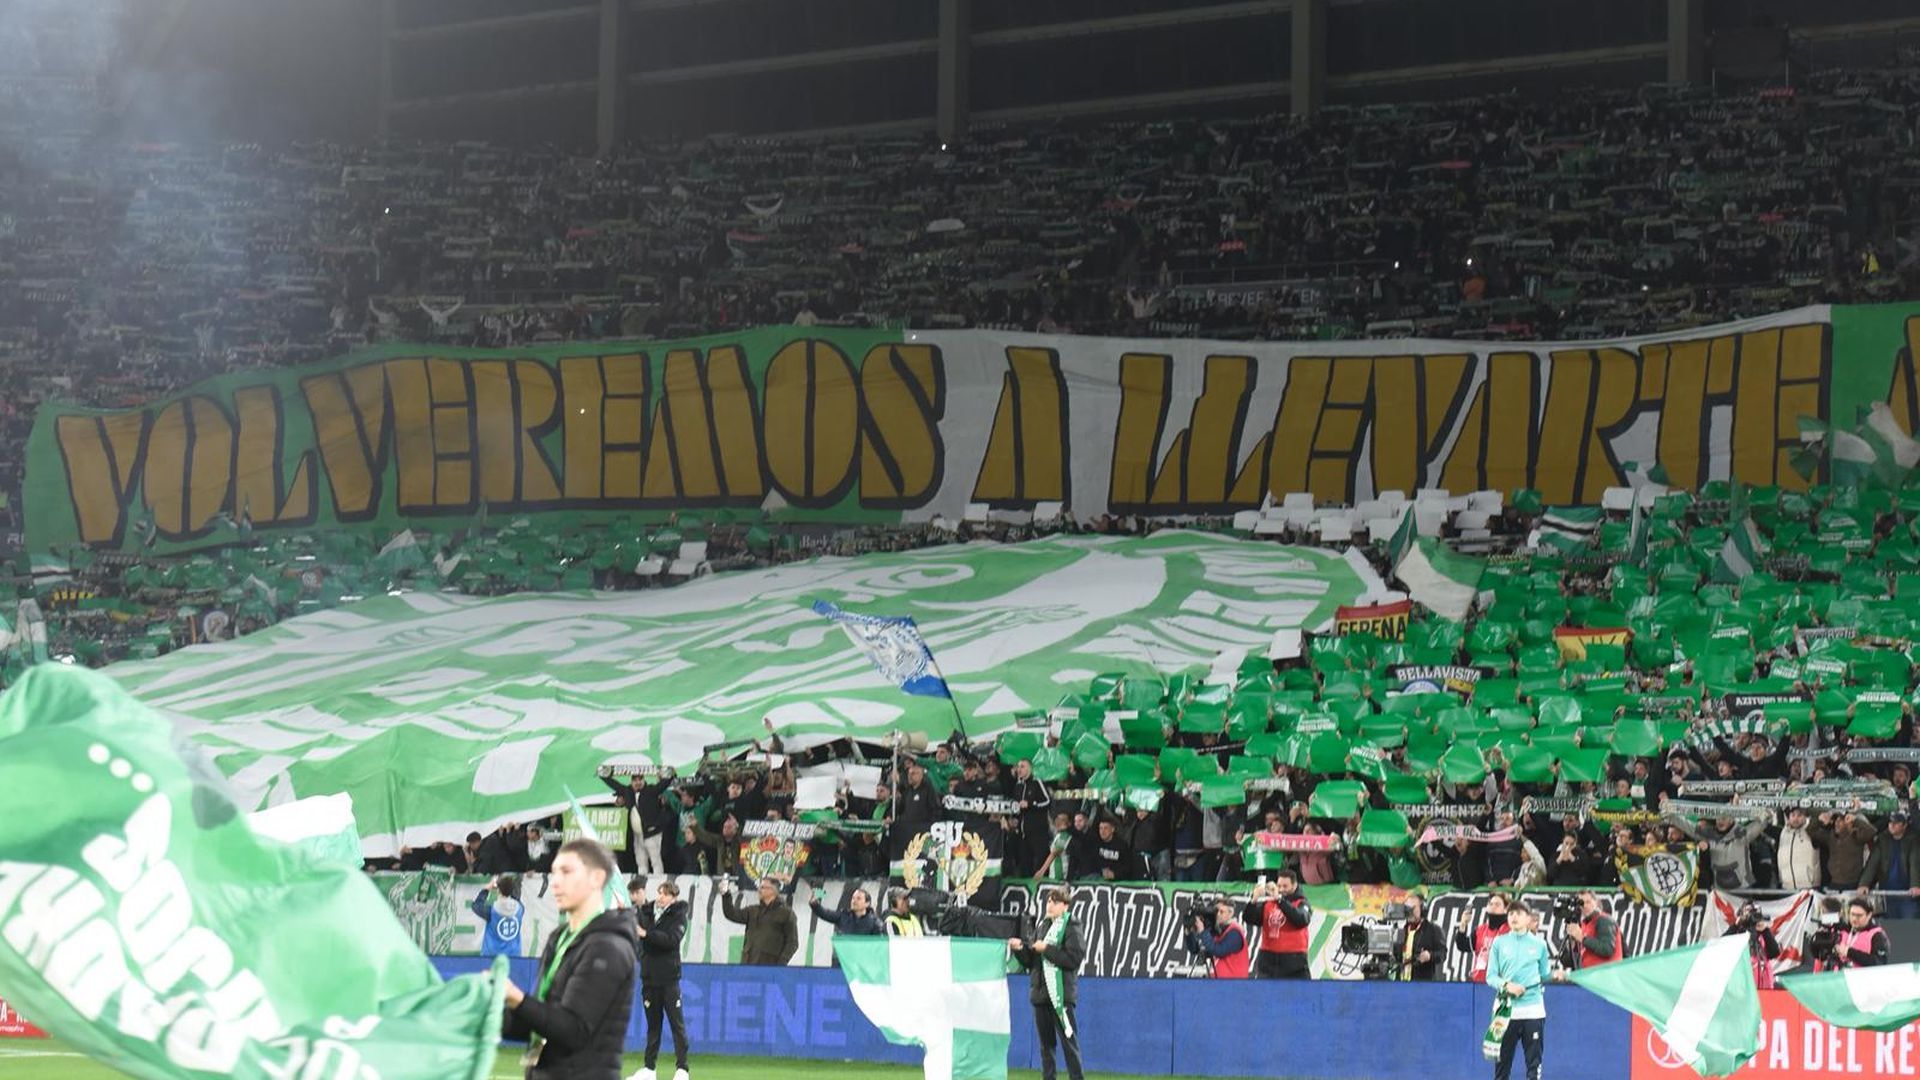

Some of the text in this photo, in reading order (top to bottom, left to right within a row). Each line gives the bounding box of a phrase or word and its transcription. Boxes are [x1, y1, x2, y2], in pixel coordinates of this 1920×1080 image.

[54, 337, 946, 549] VOLVEREMOS
[971, 345, 1072, 509] A
[1106, 320, 1833, 512] LLEVARTE
[1396, 666, 1481, 681] BELLAVISTA
[1803, 1018, 1864, 1074] DEL
[1874, 1028, 1920, 1078] RE
